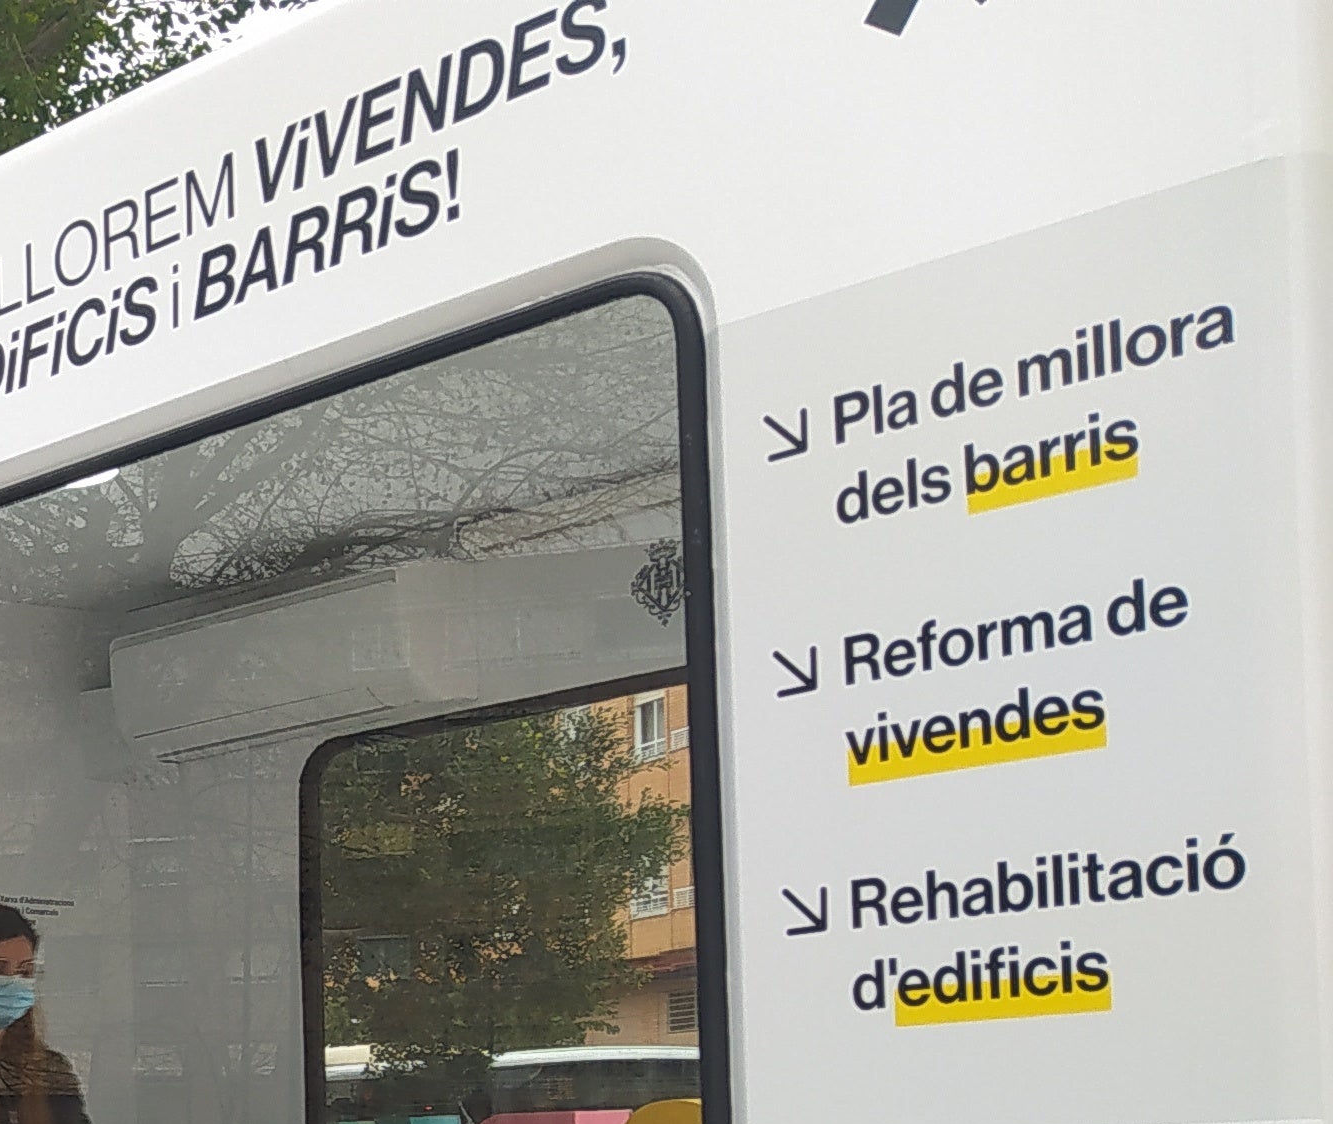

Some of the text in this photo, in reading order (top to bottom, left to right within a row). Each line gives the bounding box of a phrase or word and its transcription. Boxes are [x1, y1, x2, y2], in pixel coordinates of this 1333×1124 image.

[172, 263, 179, 329] i
[833, 305, 1235, 445] Pla de millora
[836, 412, 1139, 524] dels barris
[843, 578, 1189, 686] Reforma de
[845, 686, 1105, 766] vivendes
[850, 832, 1246, 929] Rehabilitació
[852, 940, 1109, 1011] d'edificis
